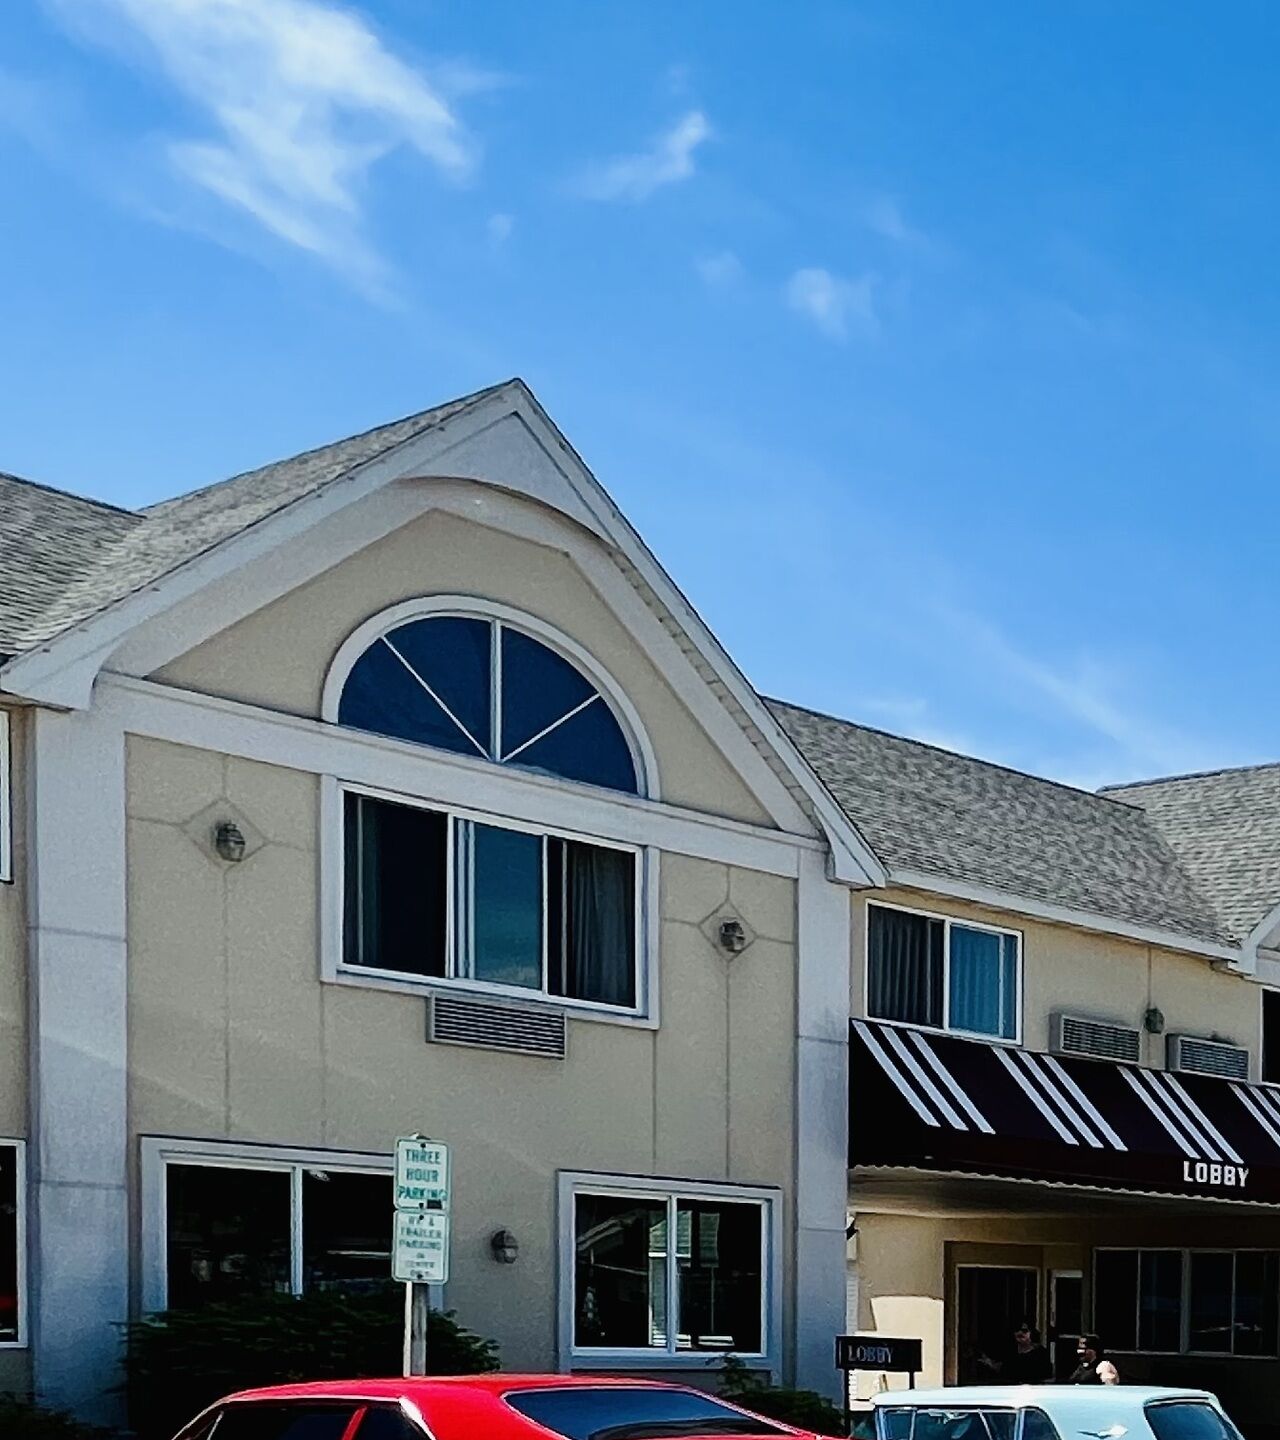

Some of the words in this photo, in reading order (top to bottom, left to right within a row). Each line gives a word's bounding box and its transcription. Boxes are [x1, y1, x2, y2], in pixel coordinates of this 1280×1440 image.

[406, 1149, 441, 1164] THREE
[406, 1168, 438, 1182] HOUR
[1183, 1160, 1249, 1187] LOBBY
[398, 1185, 448, 1201] PARKING
[848, 1345, 893, 1363] LOBBY
